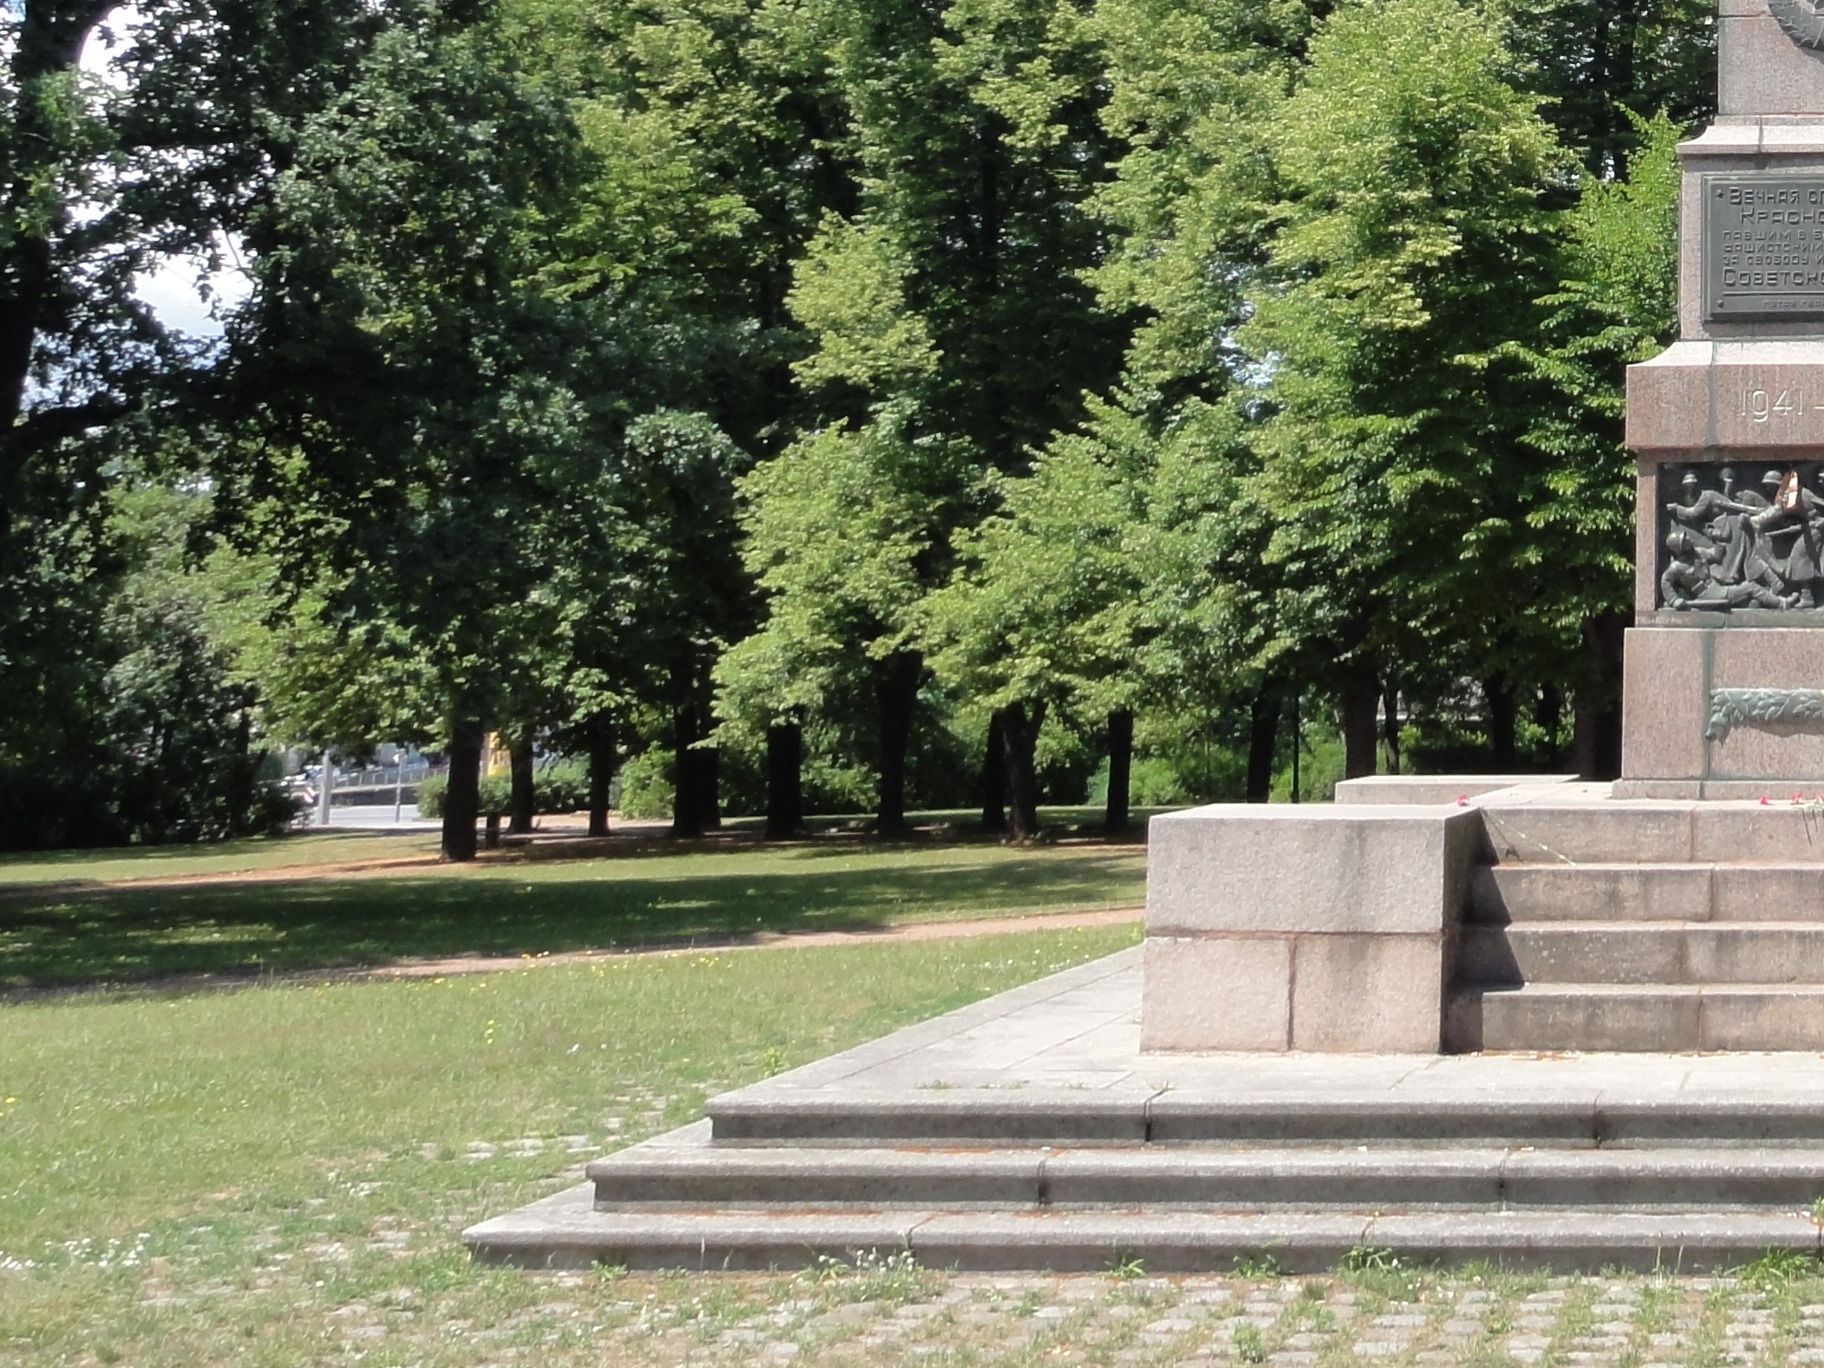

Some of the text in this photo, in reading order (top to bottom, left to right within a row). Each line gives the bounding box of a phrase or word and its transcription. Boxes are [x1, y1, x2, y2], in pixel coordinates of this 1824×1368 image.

[1728, 185, 1800, 206] ВЕЧНАЯ
[1722, 229, 1792, 242] ПАВШИМ
[1740, 388, 1804, 422] 1941
